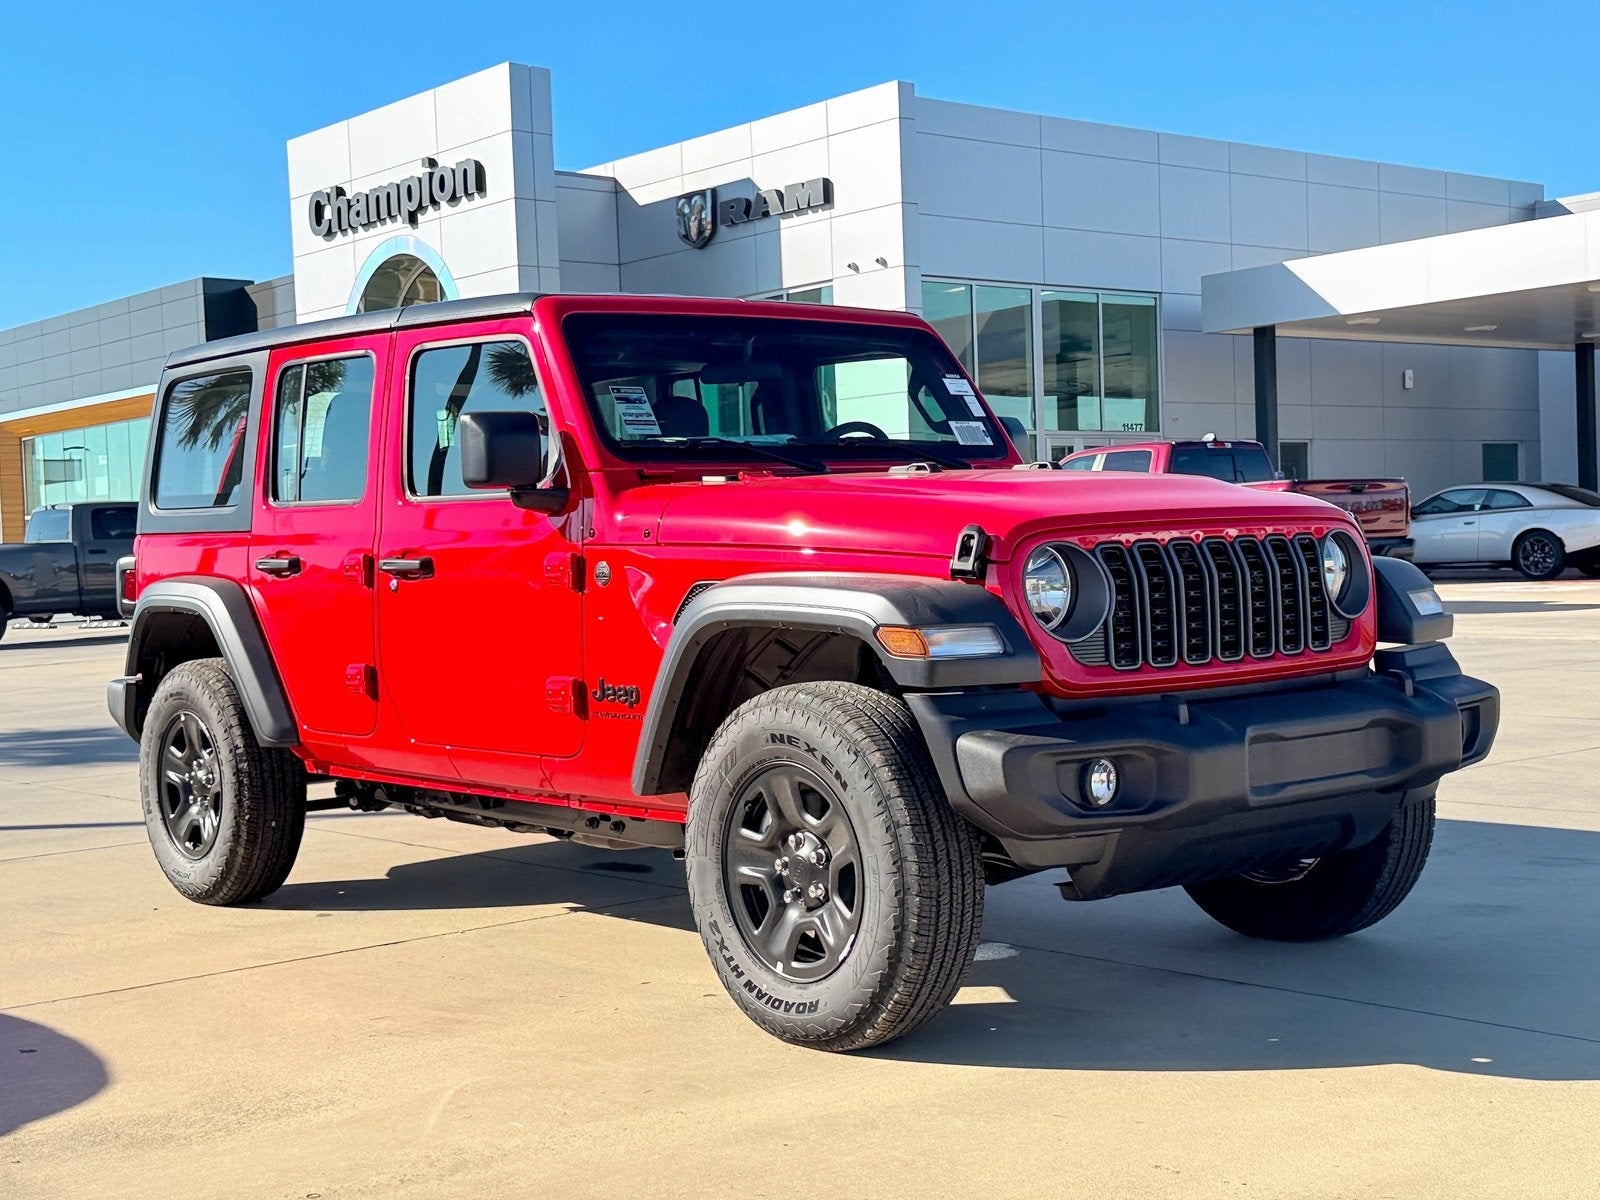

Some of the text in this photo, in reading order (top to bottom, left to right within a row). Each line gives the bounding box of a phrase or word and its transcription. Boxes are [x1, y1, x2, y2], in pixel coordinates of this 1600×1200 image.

[308, 157, 485, 241] Champion
[719, 177, 832, 226] RAM
[1121, 423, 1144, 432] 11477
[592, 678, 640, 709] Jeep
[599, 711, 643, 721] WRANGLER
[769, 732, 848, 792] NEXEN
[708, 919, 820, 1015] ROADIAN HTX2
